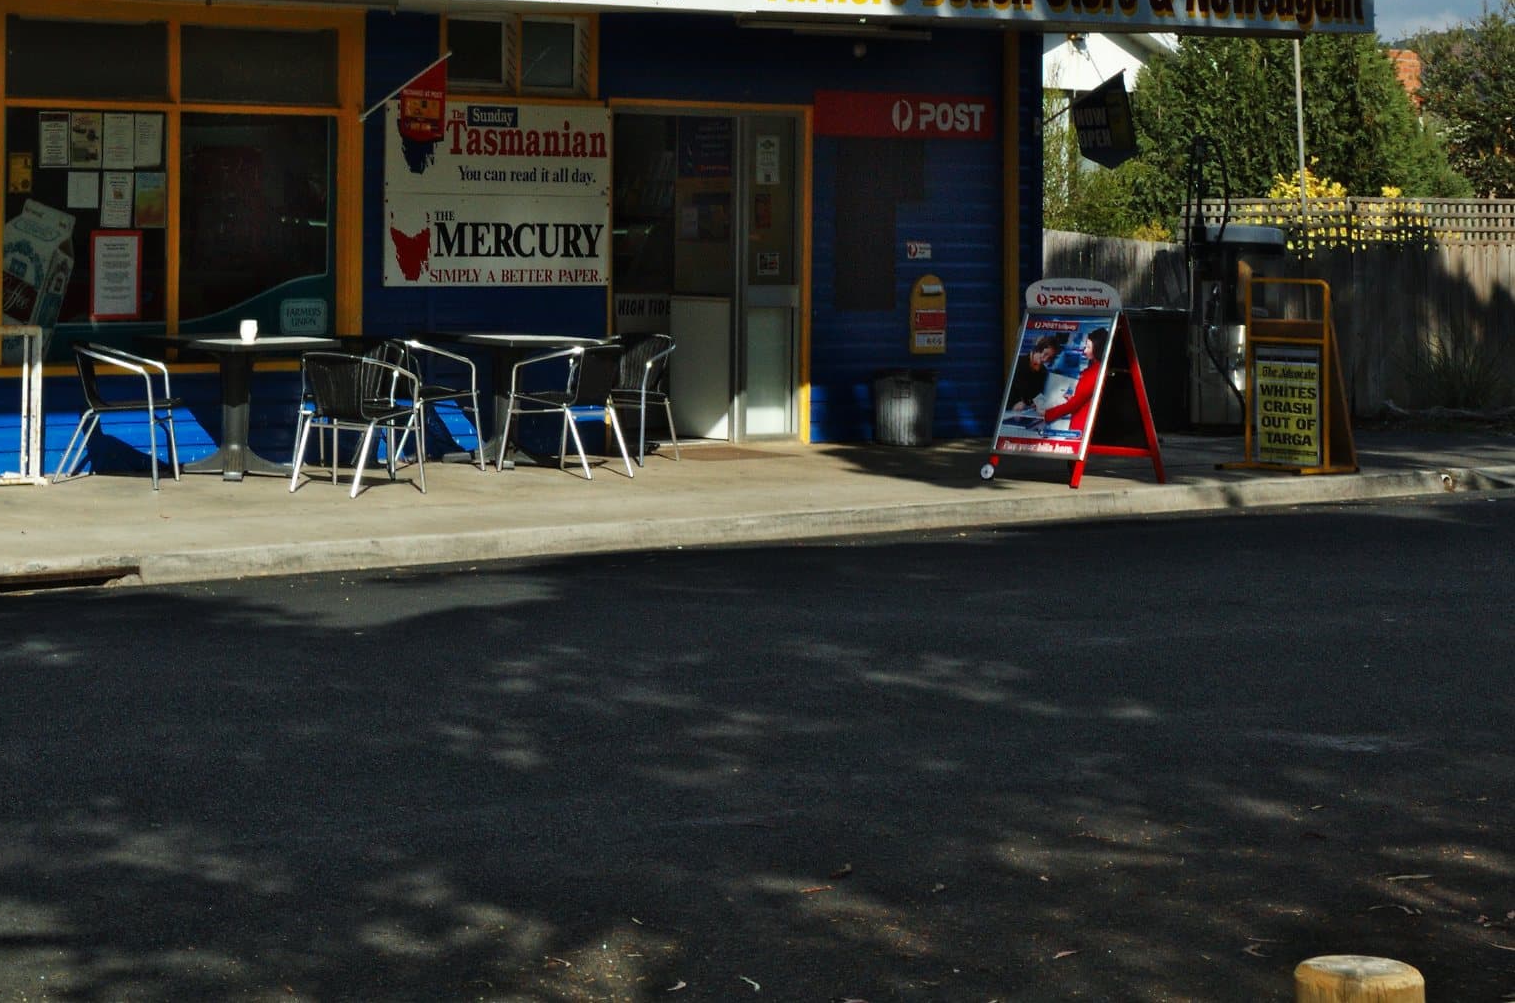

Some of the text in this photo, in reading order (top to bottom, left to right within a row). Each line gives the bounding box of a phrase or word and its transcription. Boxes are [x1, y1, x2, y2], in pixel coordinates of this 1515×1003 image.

[472, 108, 514, 127] Sunday
[919, 101, 985, 132] POST
[446, 120, 607, 157] Tasmanian
[458, 165, 596, 185] You can read it all day.
[435, 211, 454, 221] THE
[434, 222, 604, 258] MERCURY
[430, 269, 602, 284] SIMPLY A BETTER PAPER.
[618, 299, 644, 316] HIGH
[1049, 295, 1109, 308] POST billpay
[1260, 384, 1316, 399] WHITES
[1264, 401, 1312, 414] CRASH
[1262, 416, 1316, 430] OUT OF
[1266, 432, 1312, 446] TARGA
